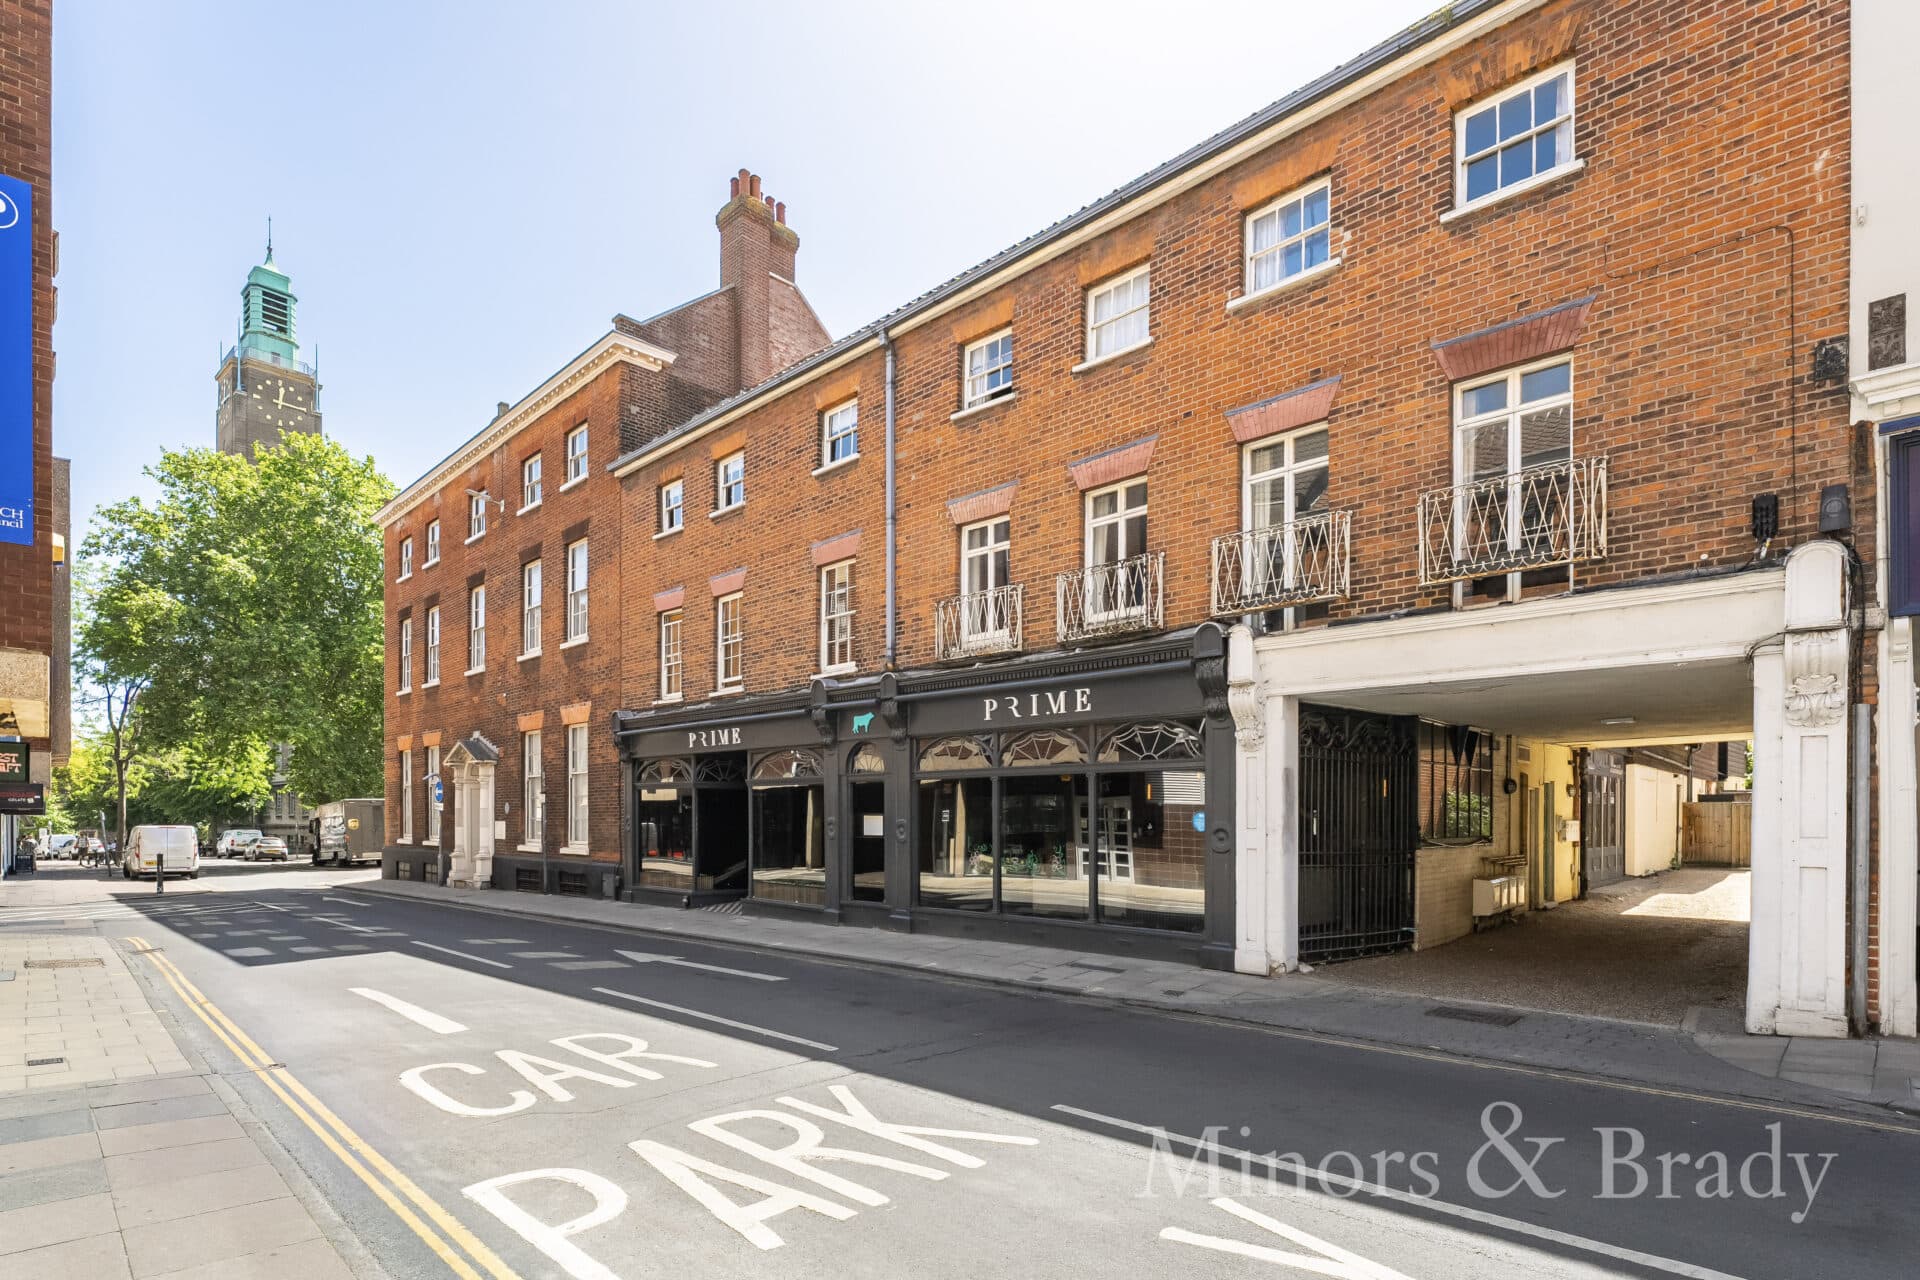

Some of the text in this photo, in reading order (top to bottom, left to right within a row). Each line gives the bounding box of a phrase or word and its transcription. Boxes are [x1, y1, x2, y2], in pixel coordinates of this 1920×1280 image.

[0, 519, 23, 529] ncil
[984, 687, 1092, 721] PRIME
[688, 727, 741, 748] PRIME
[398, 1032, 718, 1117] CAR
[461, 1084, 1040, 1280] PARK
